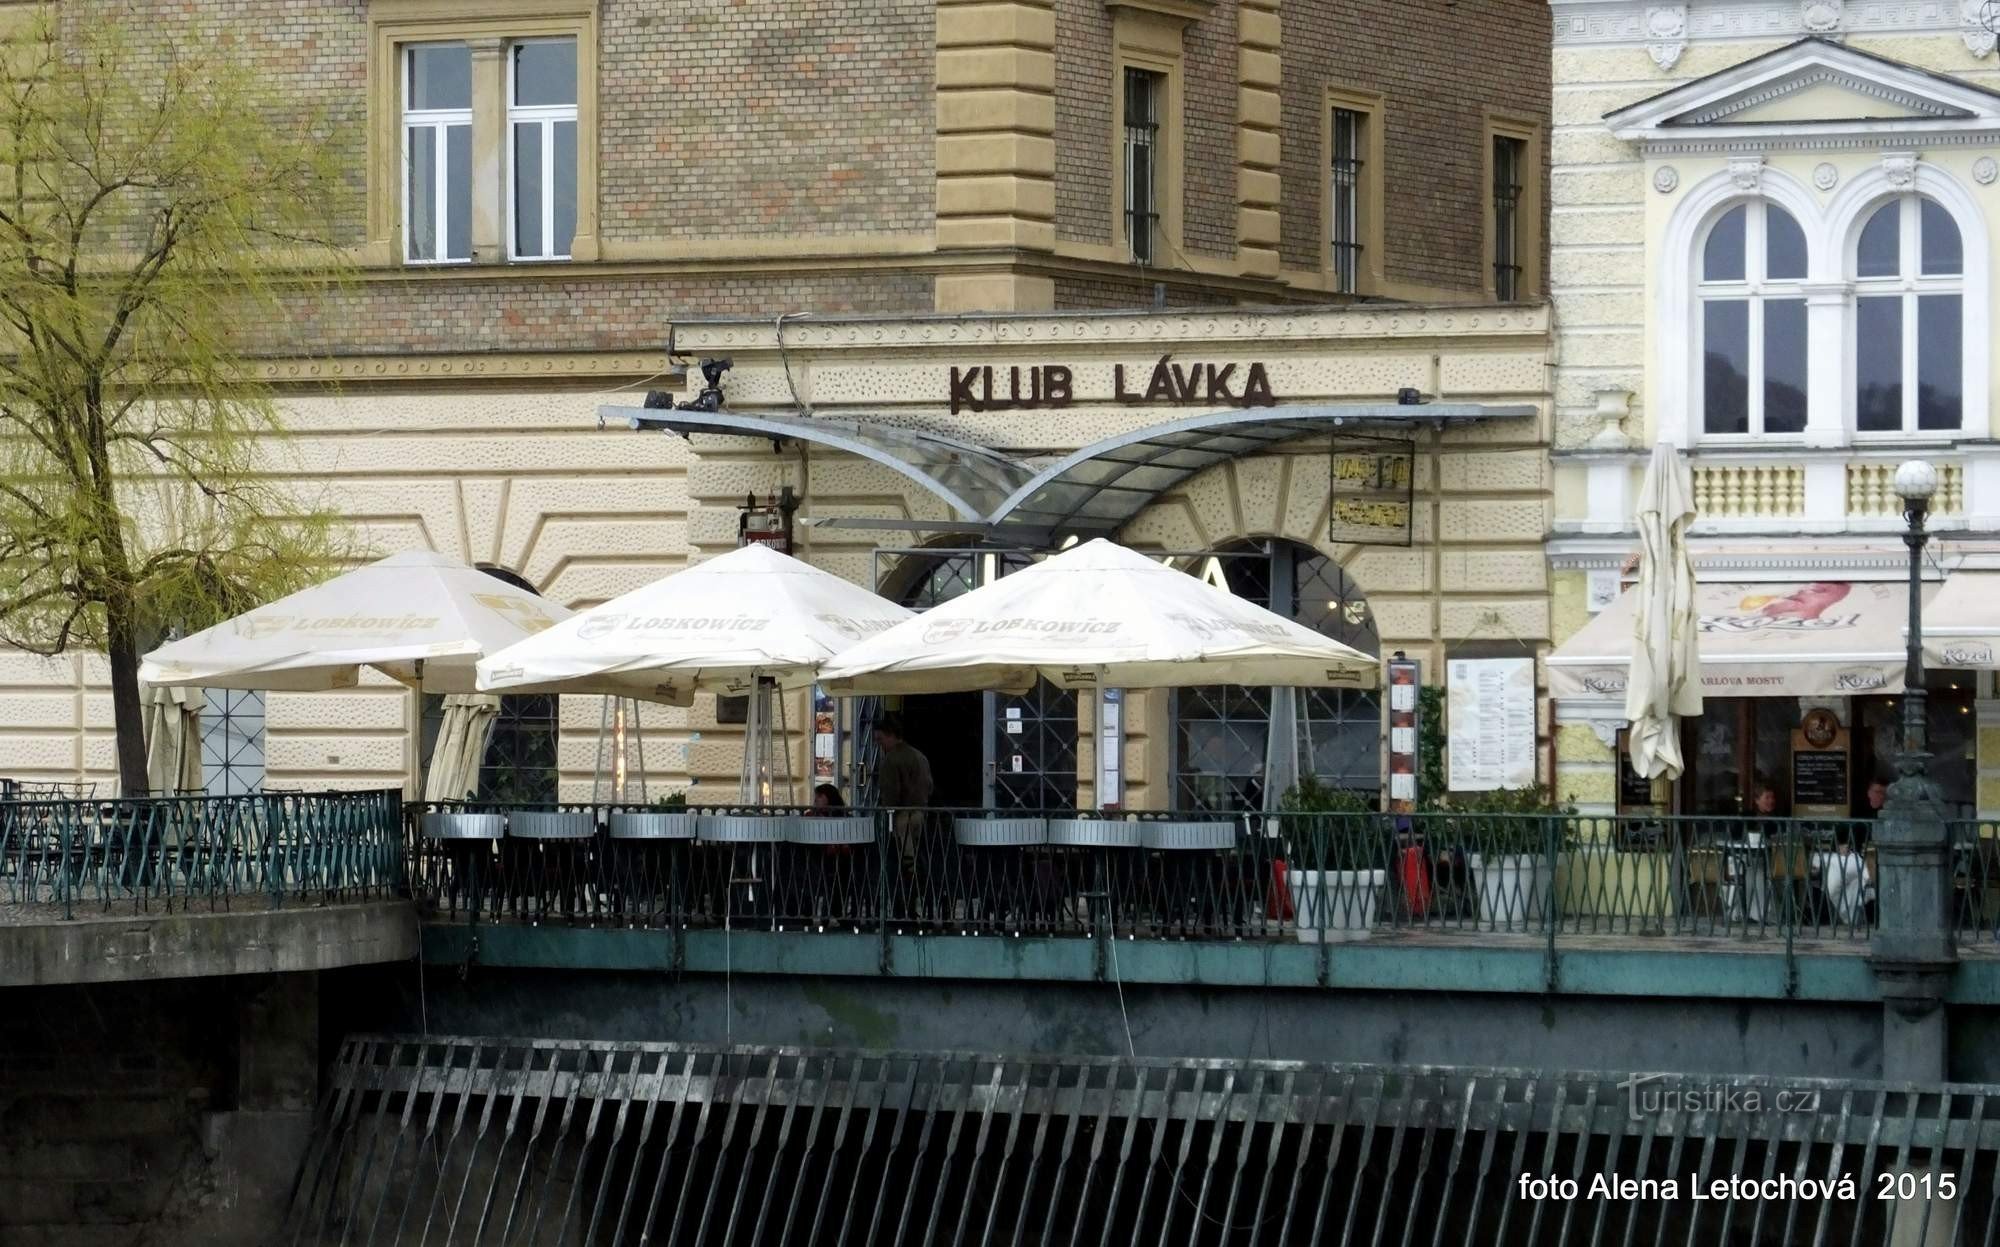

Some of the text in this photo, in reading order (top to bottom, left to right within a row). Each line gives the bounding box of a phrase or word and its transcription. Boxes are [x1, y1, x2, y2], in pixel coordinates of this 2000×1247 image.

[950, 354, 1276, 415] KLUB LÁVKA
[1942, 648, 1992, 665] Kozel
[1583, 676, 1628, 694] Koze
[1701, 676, 1742, 686] ARLOVA
[1835, 672, 1887, 690] Kozel
